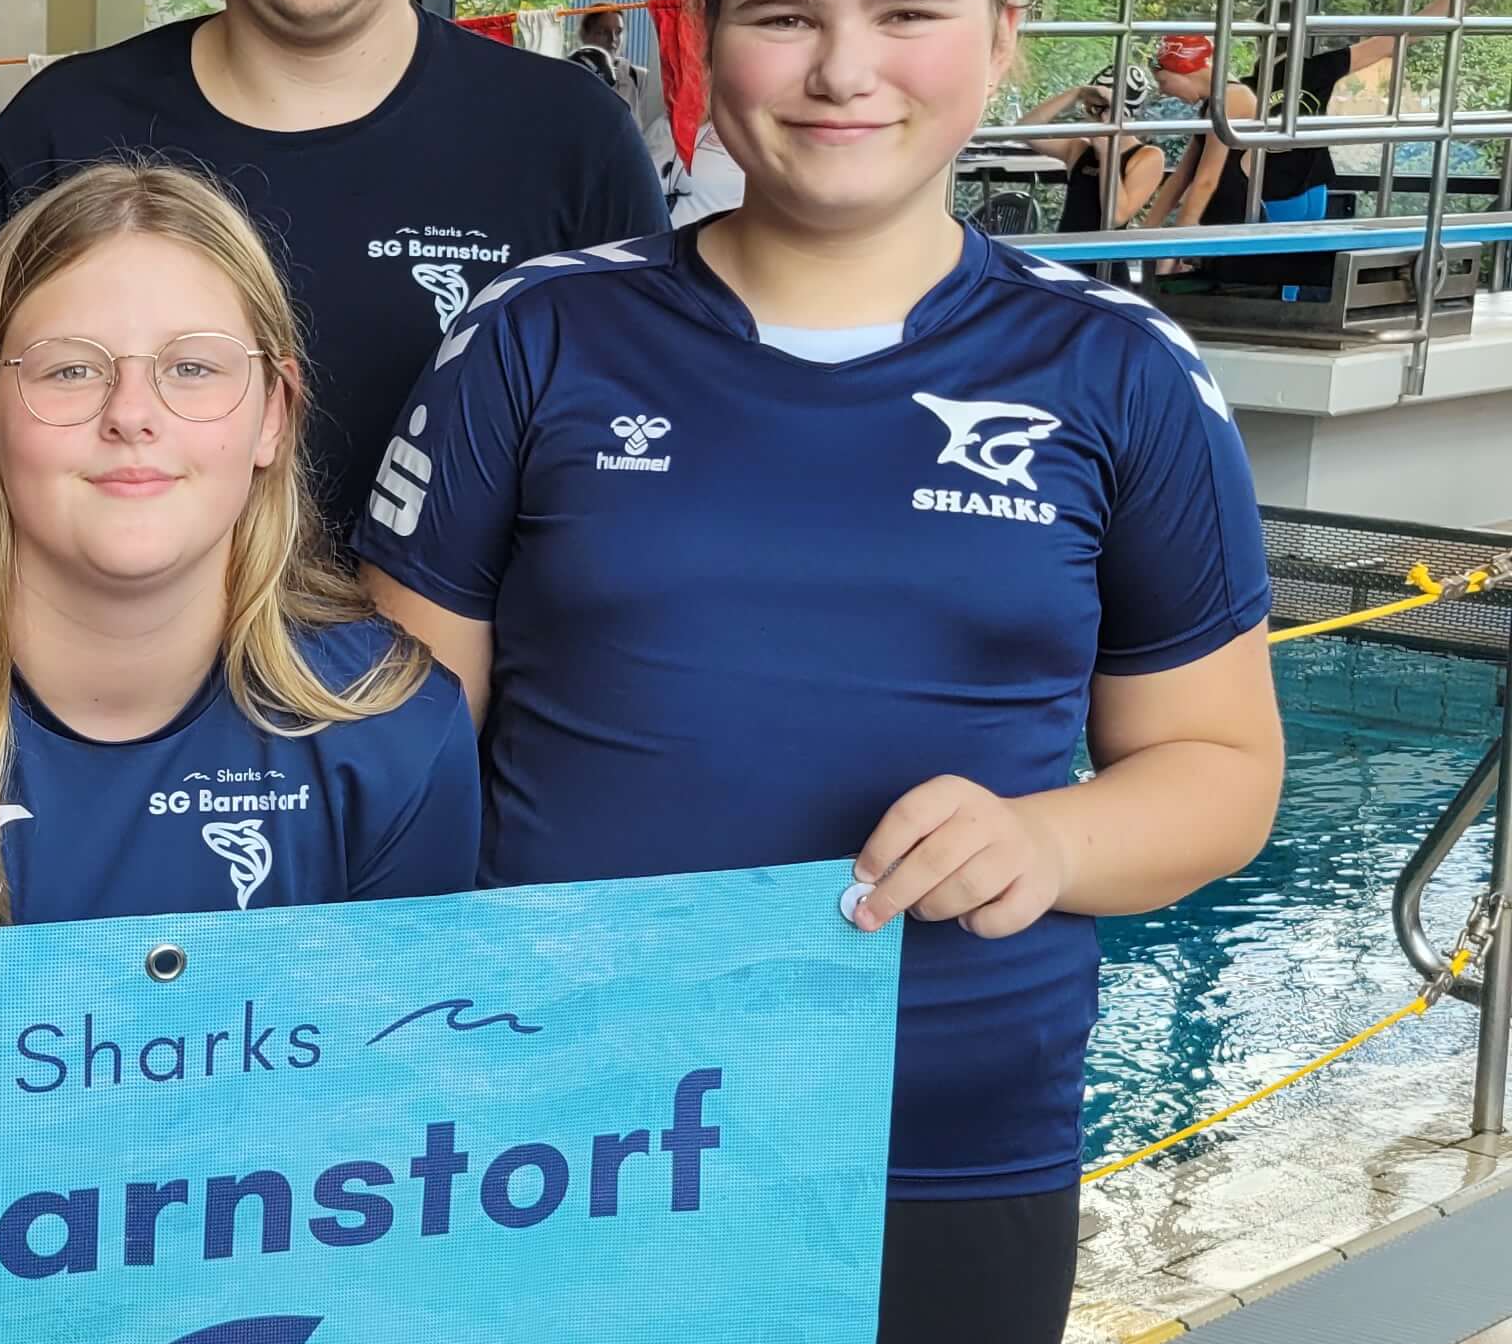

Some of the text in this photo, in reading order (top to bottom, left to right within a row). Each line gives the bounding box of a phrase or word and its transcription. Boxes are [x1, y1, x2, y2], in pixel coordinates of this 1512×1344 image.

[424, 226, 463, 237] Sharks
[367, 239, 511, 264] SG Barnstorf
[596, 451, 671, 473] hummel
[912, 488, 1057, 526] SHARKS
[216, 768, 262, 783] Sharks
[148, 784, 310, 815] SG Barnstorf
[14, 999, 325, 1100] Sharks
